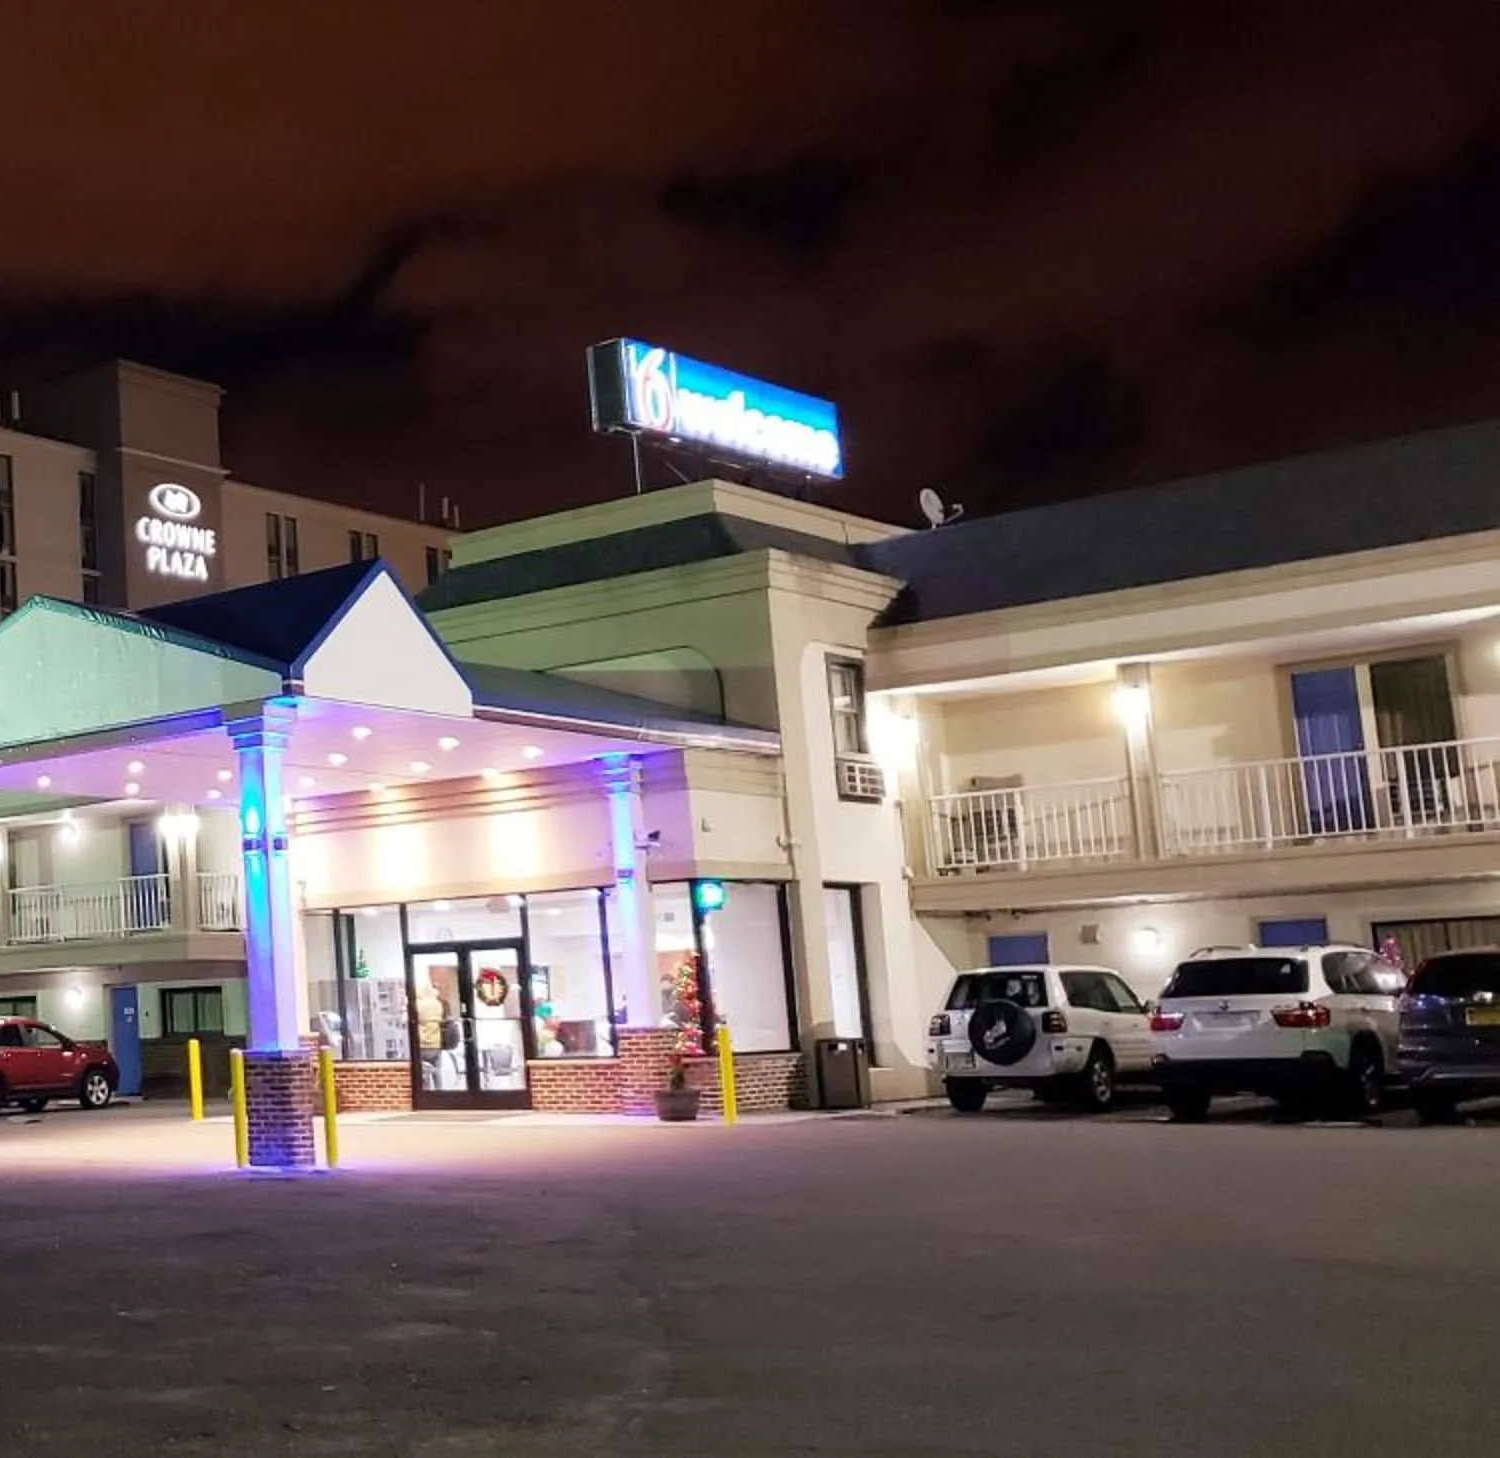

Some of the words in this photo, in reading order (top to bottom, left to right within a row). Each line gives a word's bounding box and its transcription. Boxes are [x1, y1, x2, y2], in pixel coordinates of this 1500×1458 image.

[637, 348, 673, 431] 6
[135, 516, 216, 557] CROWNE
[146, 545, 209, 582] PLAZA
